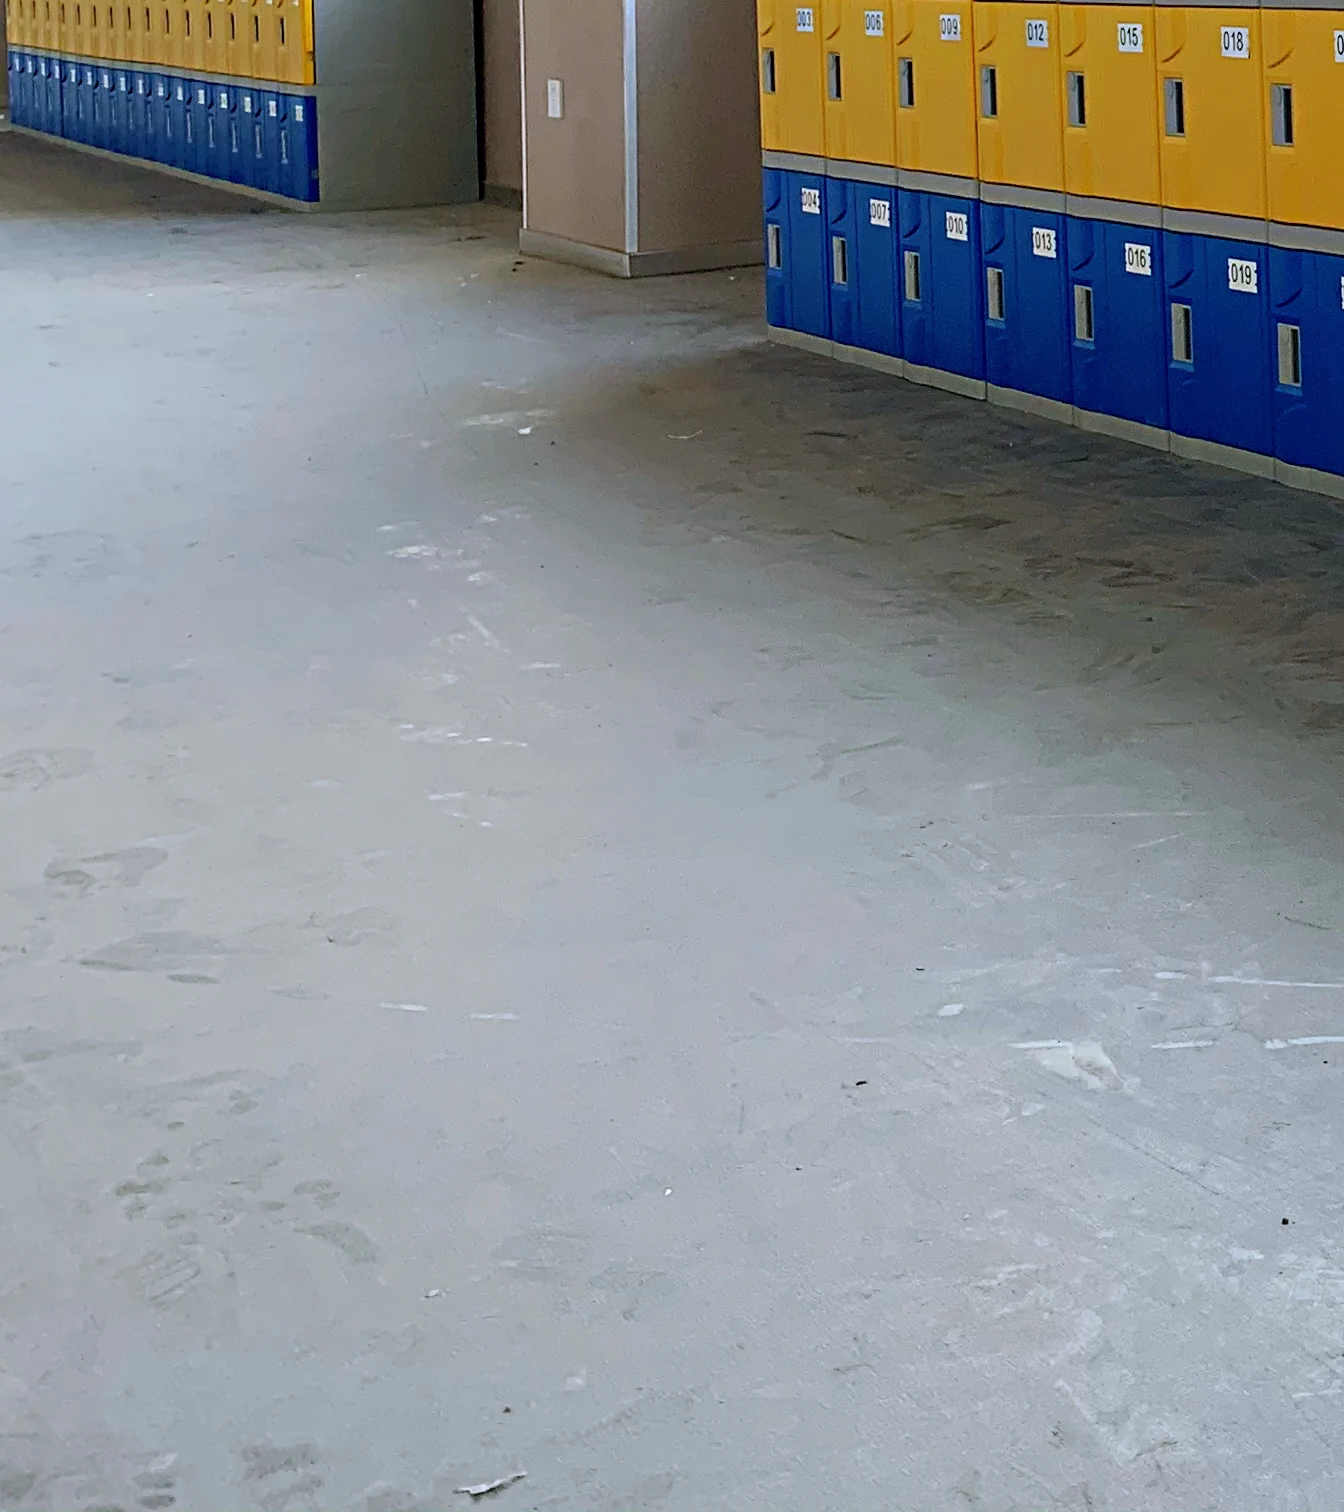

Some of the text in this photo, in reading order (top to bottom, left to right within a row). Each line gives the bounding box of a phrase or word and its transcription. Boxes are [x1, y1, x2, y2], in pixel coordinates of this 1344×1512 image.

[866, 14, 882, 30] 006
[942, 18, 958, 35] 009
[1028, 23, 1044, 41] 012
[1120, 27, 1138, 46] 015
[1224, 31, 1243, 51] 018
[872, 204, 887, 220] 007
[948, 217, 964, 234] 010
[1035, 232, 1052, 252] 013
[1128, 248, 1146, 268] 016
[1231, 263, 1251, 285] 019
